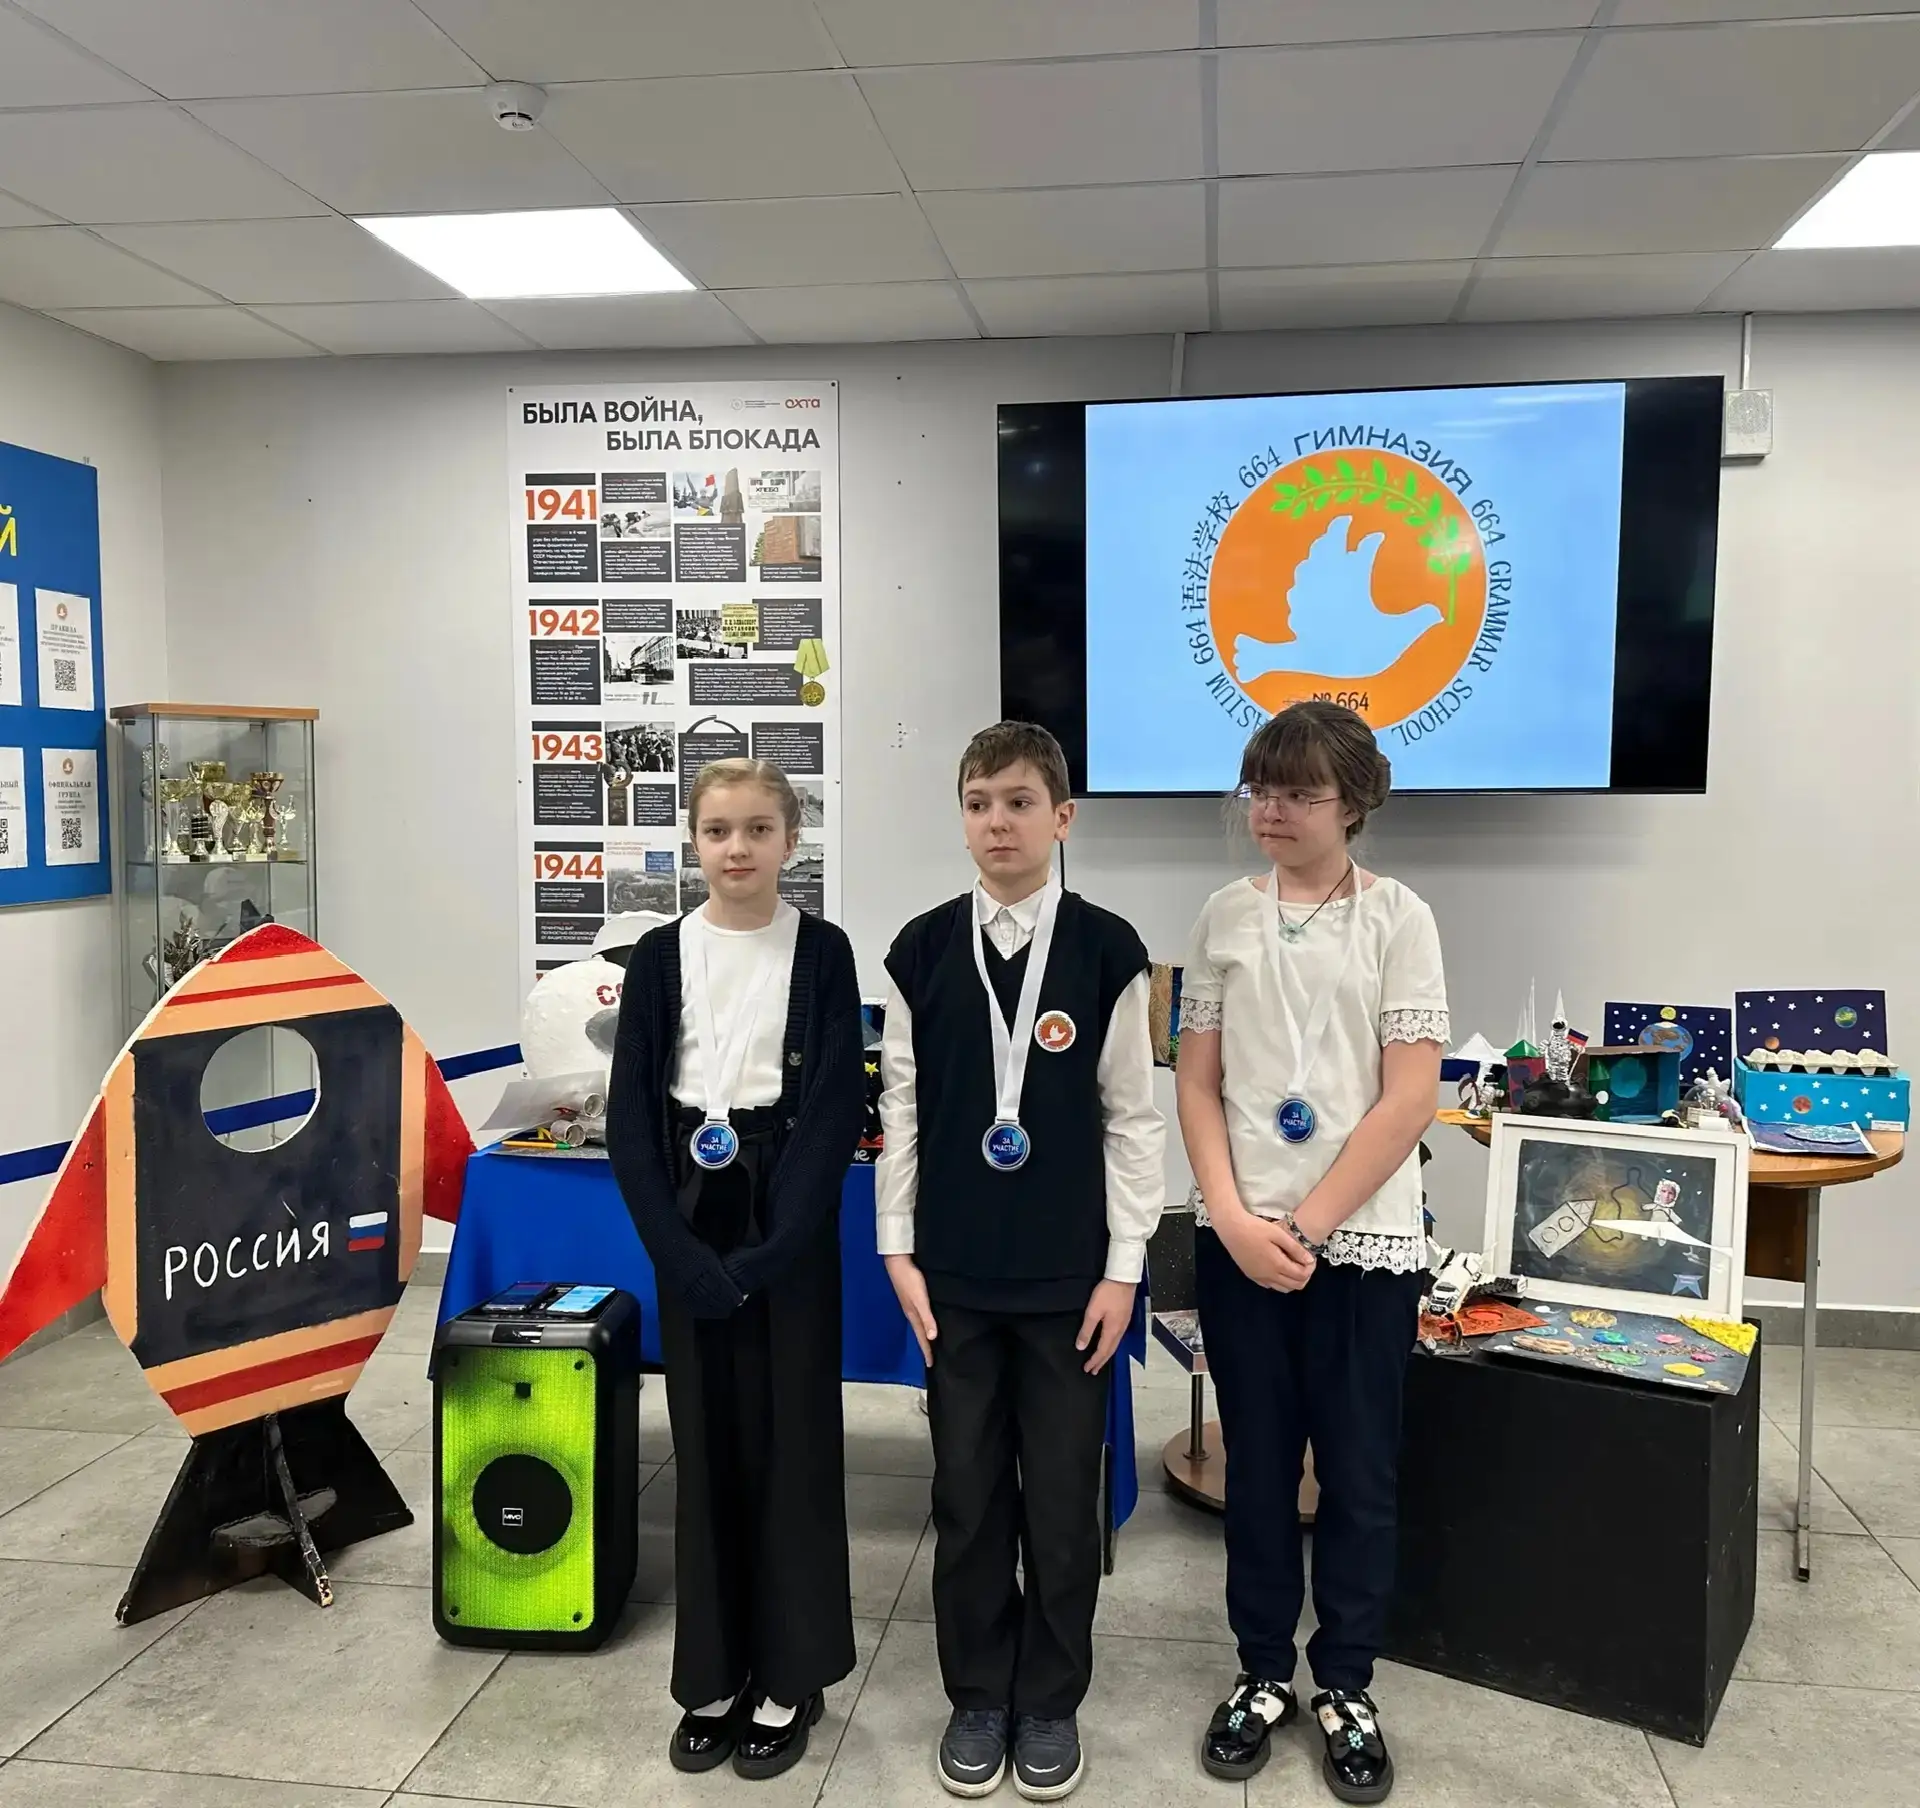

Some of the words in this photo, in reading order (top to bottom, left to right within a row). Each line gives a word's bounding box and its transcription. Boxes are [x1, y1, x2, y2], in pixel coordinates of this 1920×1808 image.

[523, 402, 597, 424] БЫЛА
[604, 396, 703, 425] ВОЙНА,
[606, 430, 682, 451] БЫЛА
[689, 428, 821, 453] БЛОКАДА
[1238, 445, 1283, 489] 664
[1293, 425, 1473, 496] ГИМНАЗИЯ
[525, 489, 597, 521] 1941
[1471, 499, 1506, 548] 664
[1181, 491, 1240, 613] 语法学校
[529, 609, 600, 636] 1942
[1467, 560, 1513, 673] GRAMMAR
[1185, 619, 1215, 665] 664
[1336, 691, 1370, 712] 664
[1391, 678, 1473, 747] SCHOOL
[532, 734, 603, 761] 1943
[534, 854, 605, 880] 1944
[700, 1143, 728, 1151] УЧАСТИЕ
[710, 1136, 719, 1144] ЗА
[992, 1143, 1020, 1153] УЧАСТИЕ
[164, 1220, 331, 1301] РОССИЯ
